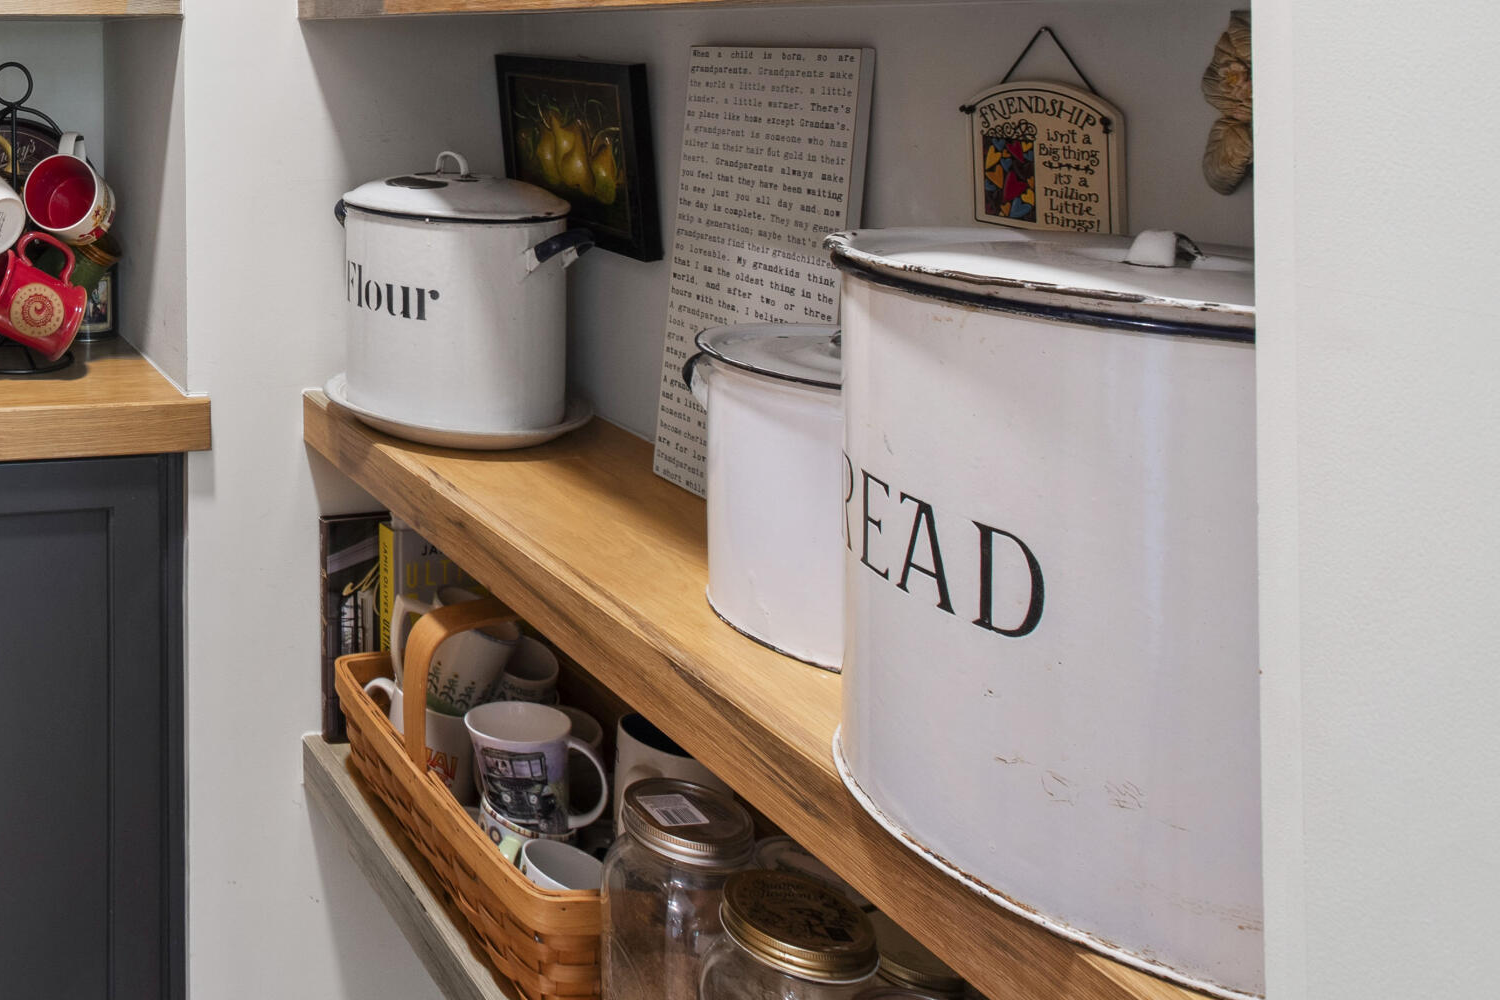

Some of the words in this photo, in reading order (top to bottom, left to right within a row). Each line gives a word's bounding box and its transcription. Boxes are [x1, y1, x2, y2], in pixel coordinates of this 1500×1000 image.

[731, 51, 753, 59] child
[758, 68, 824, 79] Grandparents
[740, 82, 765, 91] little
[822, 87, 852, 96] little
[734, 98, 762, 107] little
[699, 110, 719, 119] place
[724, 112, 740, 121] like
[745, 114, 762, 123] home
[767, 117, 794, 127] except
[980, 96, 1096, 130] FRIENDSHIP
[765, 133, 801, 144] someone
[808, 137, 823, 145] who
[830, 139, 847, 147] has
[1082, 134, 1092, 145] a
[1039, 143, 1060, 161] Big
[1062, 145, 1100, 167] thing
[1078, 177, 1089, 188] a
[1044, 186, 1099, 203] million
[1050, 199, 1095, 216] Little
[1044, 212, 1100, 233] things!
[346, 260, 440, 321] Flour
